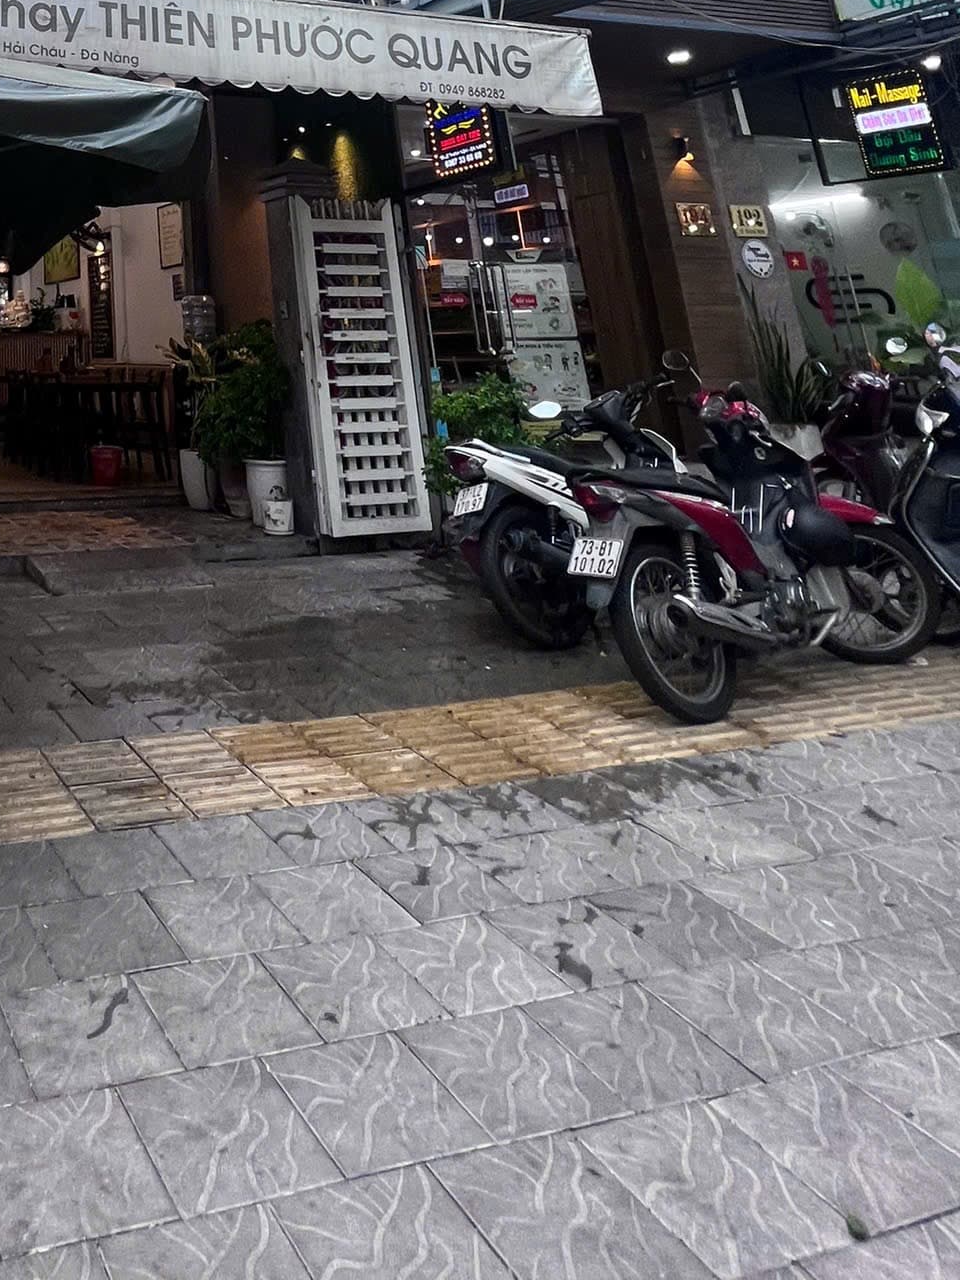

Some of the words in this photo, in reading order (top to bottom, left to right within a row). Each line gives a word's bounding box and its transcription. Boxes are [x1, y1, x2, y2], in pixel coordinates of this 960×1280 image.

[99, 1, 216, 49] THIÊN
[231, 15, 376, 64] PHƯỚC
[388, 32, 532, 80] QUANG
[3, 41, 26, 56] Hải
[30, 43, 67, 59] Châu
[80, 48, 99, 62] Đà
[439, 83, 466, 96] 0949
[468, 86, 506, 100] 868282
[573, 556, 615, 576] 101.02
